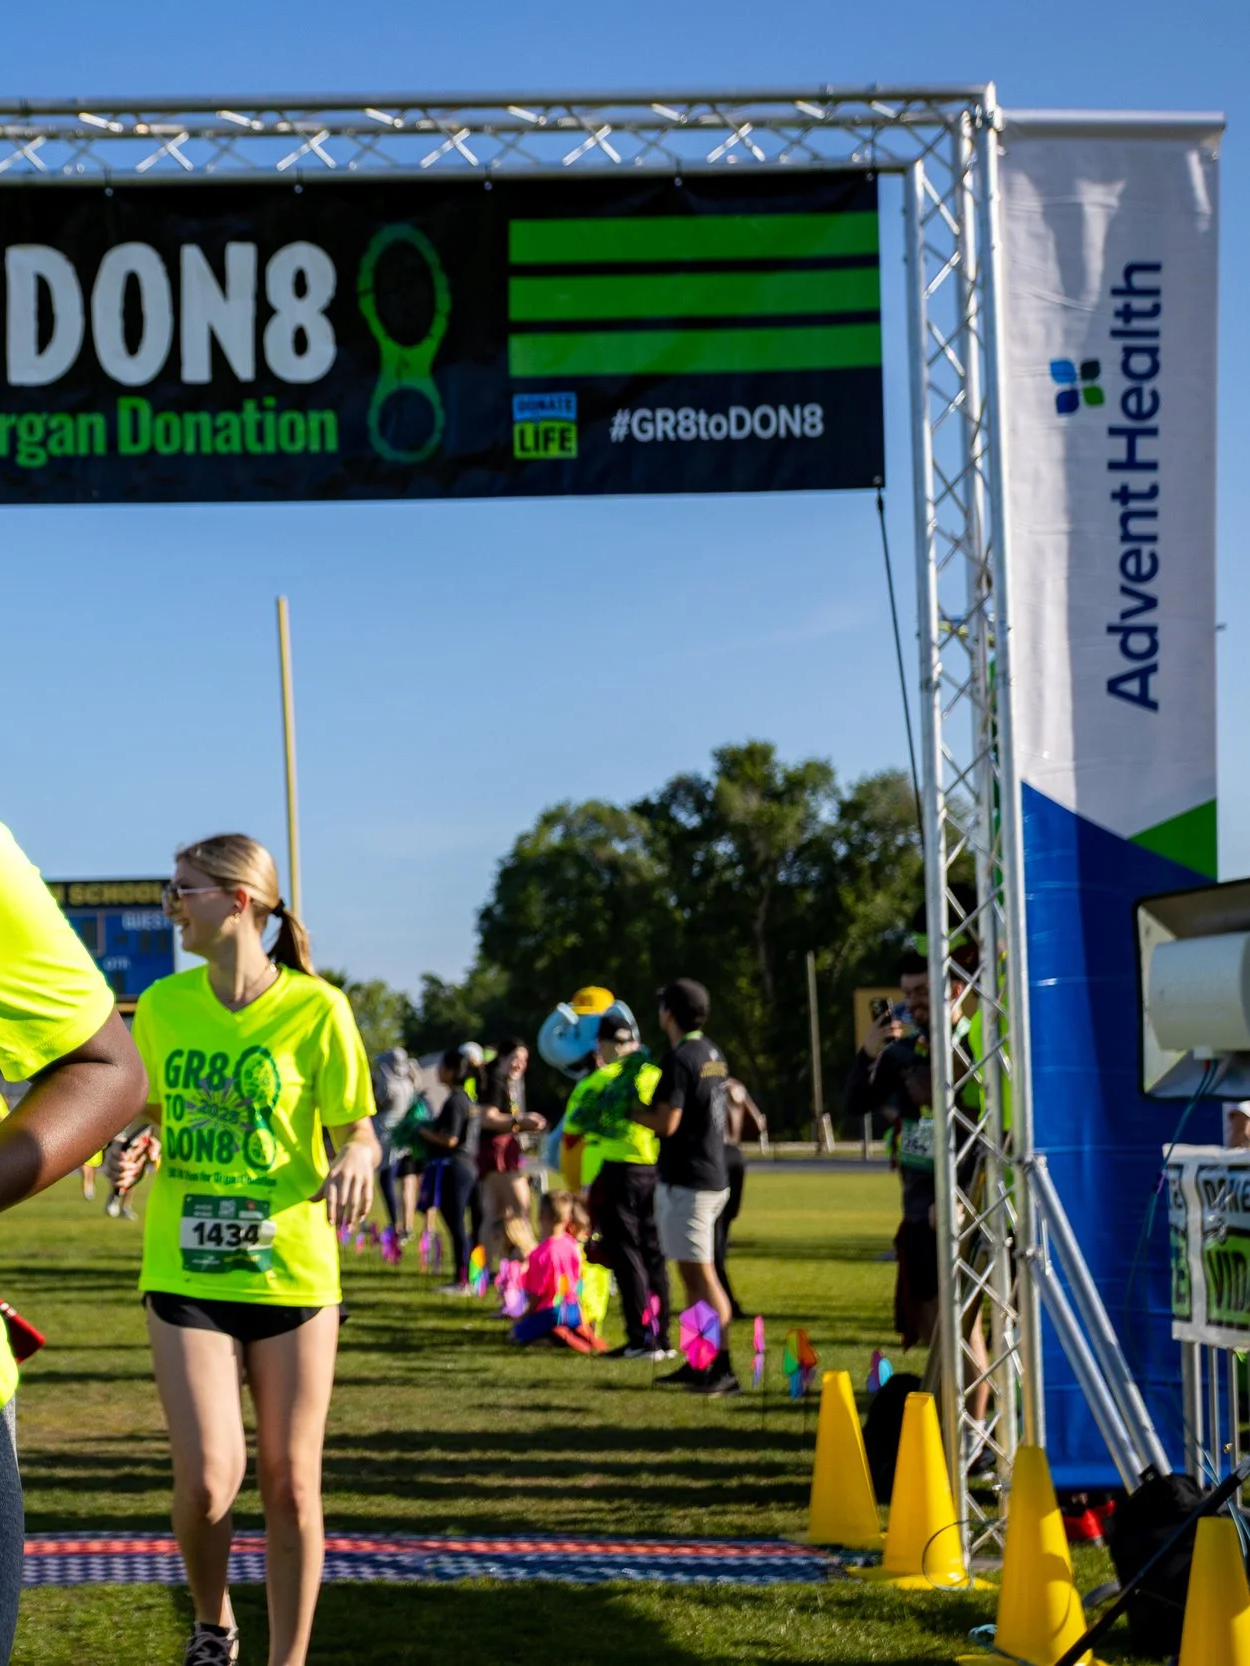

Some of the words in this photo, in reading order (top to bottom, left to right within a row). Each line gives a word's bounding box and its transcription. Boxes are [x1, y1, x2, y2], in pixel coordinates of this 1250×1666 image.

[5, 241, 338, 387] DON8
[118, 397, 338, 457] Donation
[519, 426, 573, 452] LIFE
[609, 403, 825, 442] #GR8toDON8
[1106, 261, 1162, 713] AdventHealth
[165, 1049, 230, 1091] GR8
[165, 1094, 185, 1122] TO
[197, 1099, 240, 1125] 2025
[166, 1127, 234, 1164] DON8
[193, 1222, 259, 1247] 1434
